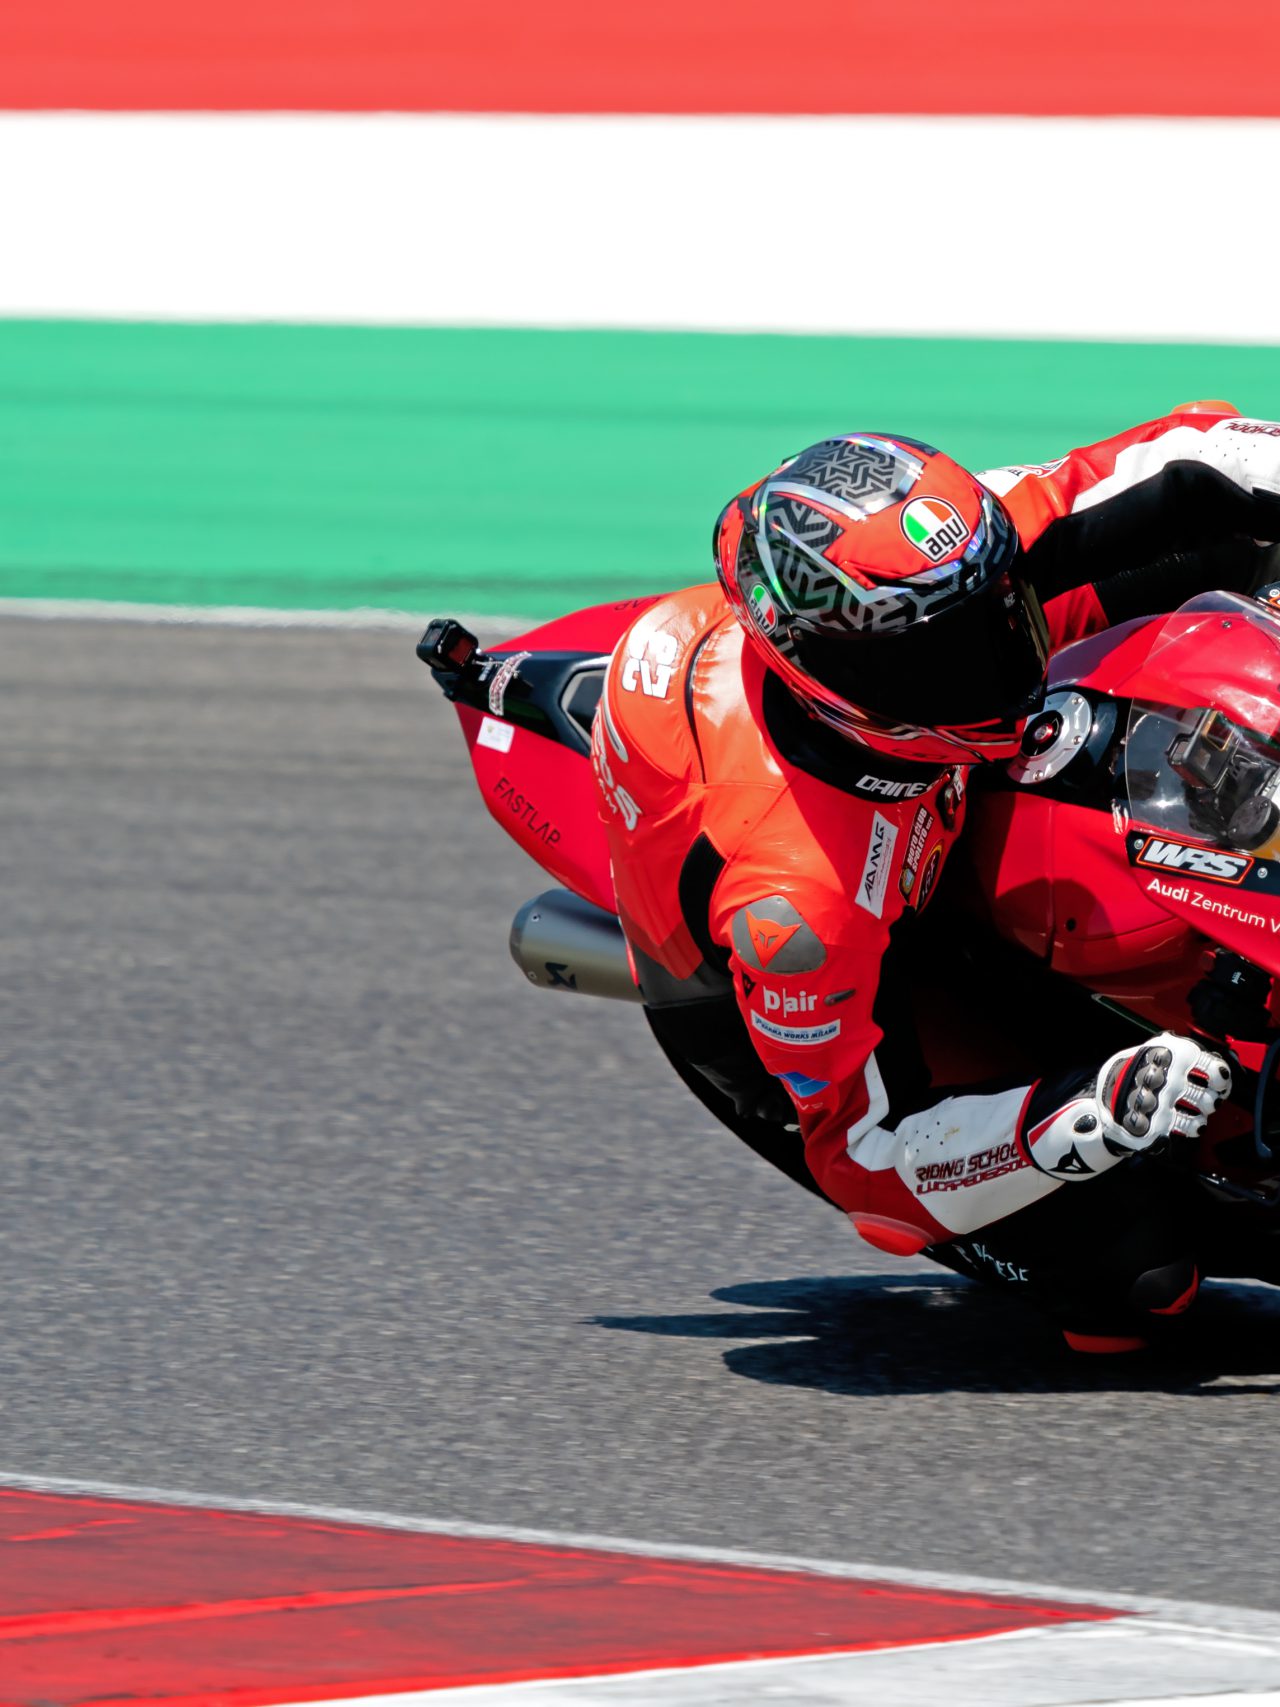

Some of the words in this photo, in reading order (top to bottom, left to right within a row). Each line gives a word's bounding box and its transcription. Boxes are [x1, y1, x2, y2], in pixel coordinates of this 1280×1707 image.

[925, 521, 963, 558] agv
[855, 774, 928, 797] DAINE
[493, 777, 561, 849] FASTLAP
[906, 832, 920, 866] MOTO
[914, 807, 927, 836] CLUB
[911, 827, 928, 872] SPOLETO
[1143, 840, 1247, 878] WRS
[1147, 878, 1189, 902] Audi
[1190, 891, 1266, 929] Zentrum
[915, 1158, 964, 1182] RIDING
[967, 1142, 1019, 1174] SCHOO
